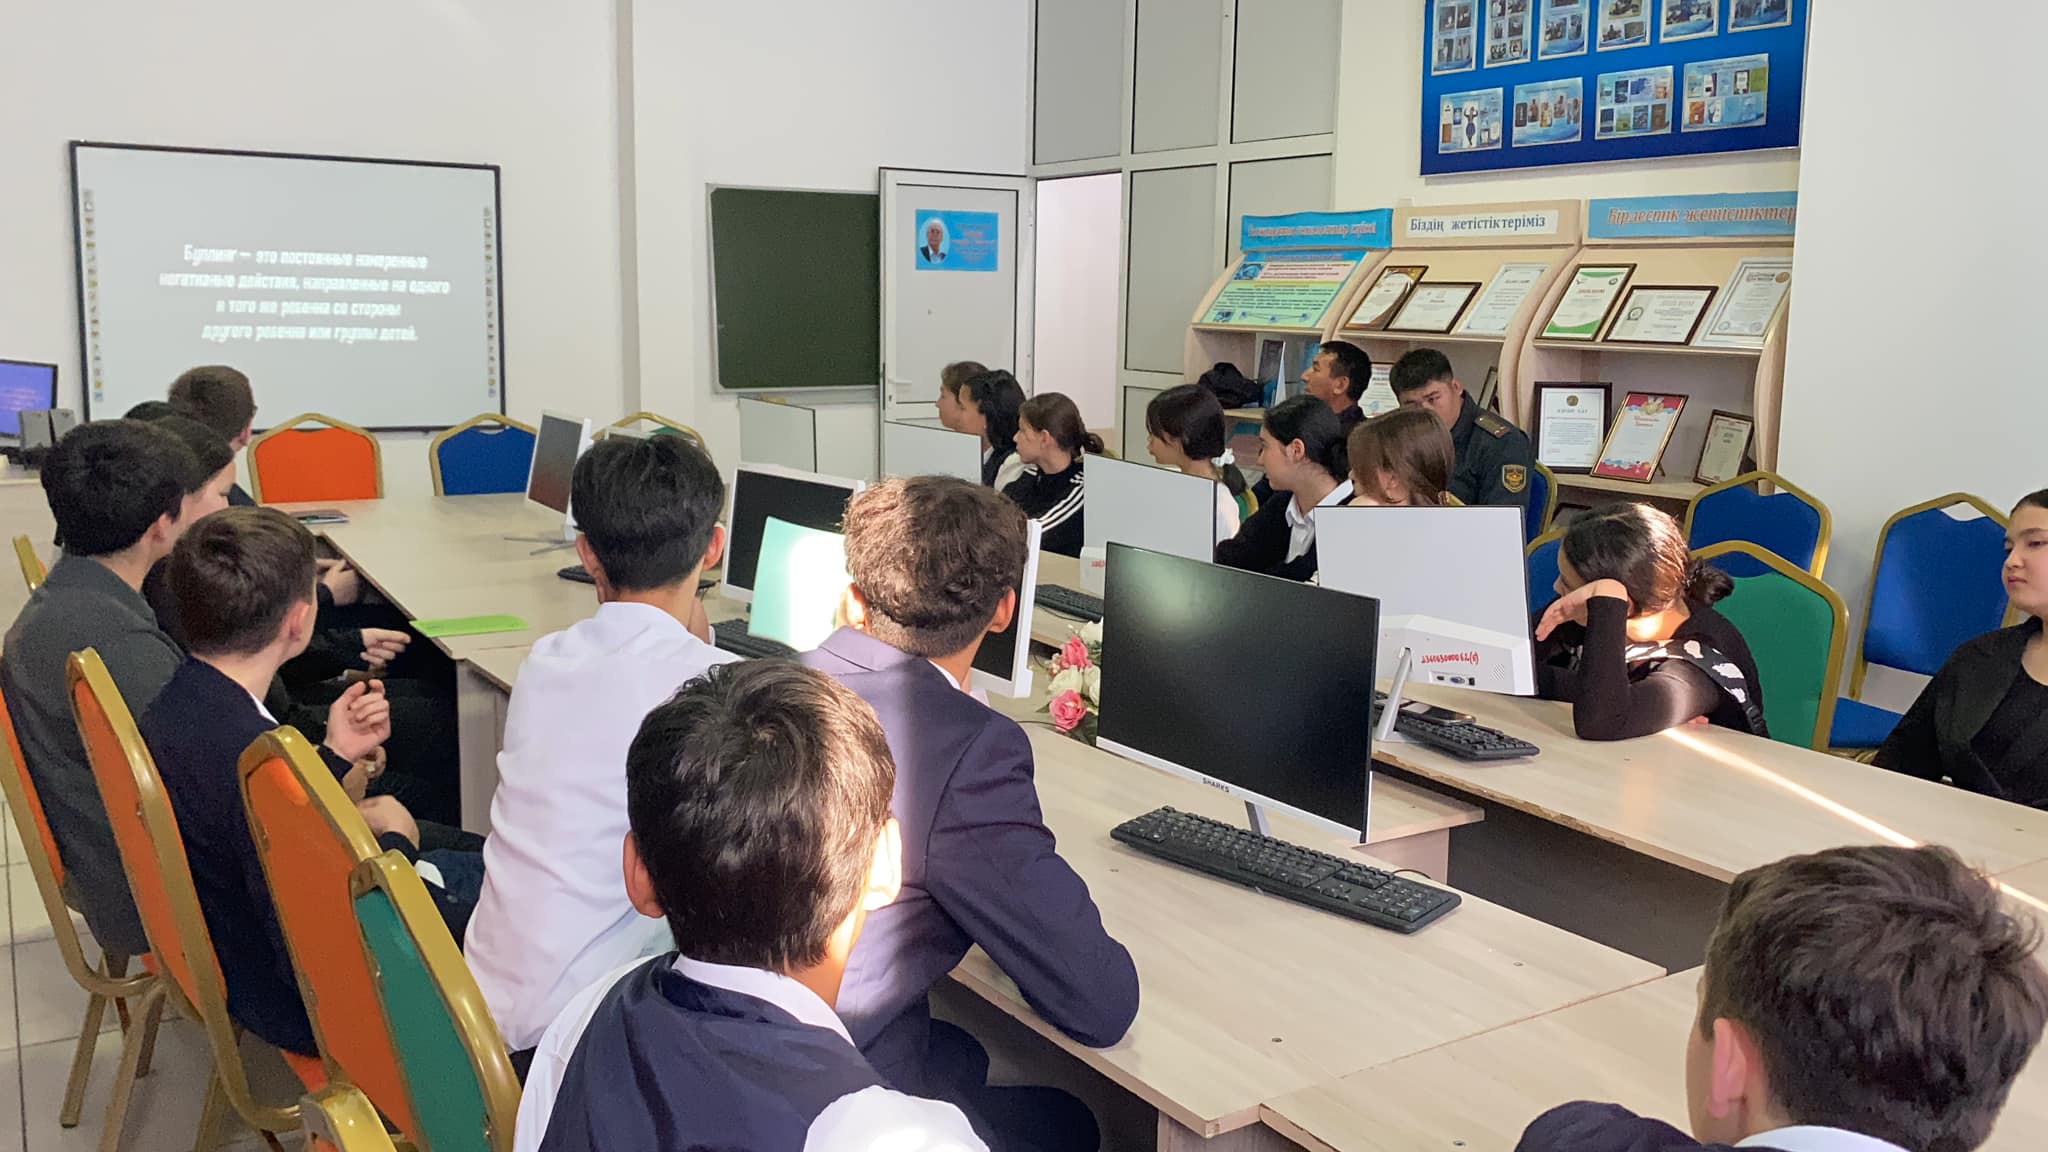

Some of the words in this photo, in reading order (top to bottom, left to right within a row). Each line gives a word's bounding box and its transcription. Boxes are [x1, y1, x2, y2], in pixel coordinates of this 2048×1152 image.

[1410, 218, 1444, 232] Біздің
[1451, 214, 1546, 231] жетістіктеріміз
[228, 300, 256, 313] того
[1202, 777, 1230, 793] SHARKS
